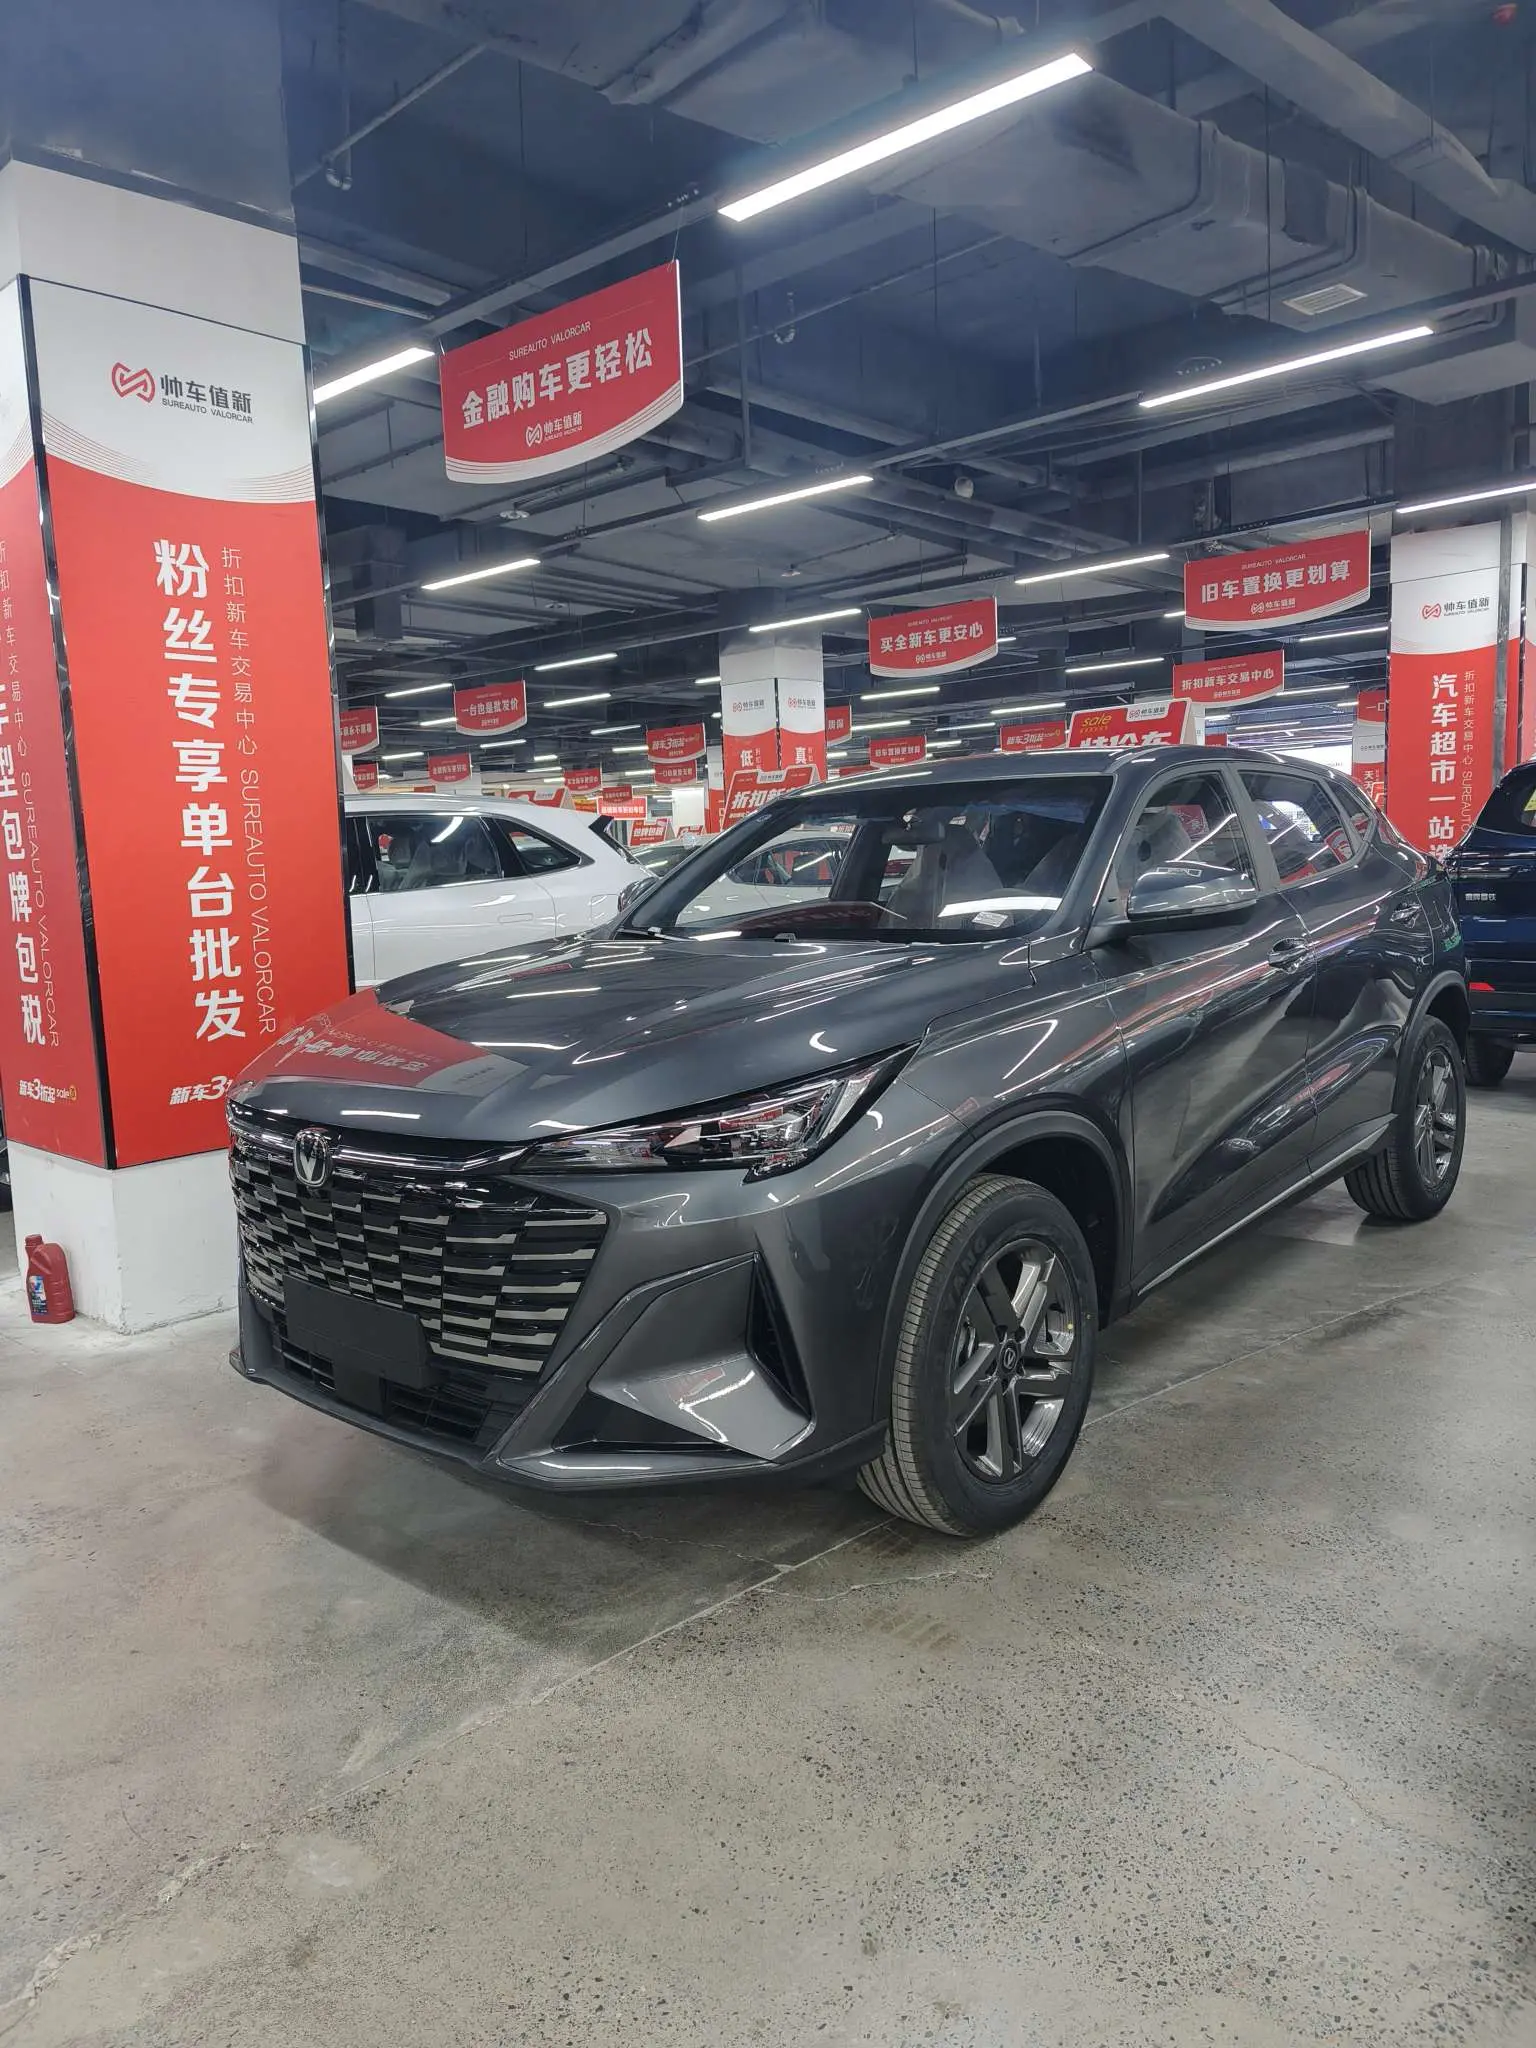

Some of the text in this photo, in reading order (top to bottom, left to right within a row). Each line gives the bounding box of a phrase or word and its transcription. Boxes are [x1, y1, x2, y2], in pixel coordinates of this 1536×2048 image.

[509, 320, 592, 361] SUREAUTO VALORCAR
[160, 374, 251, 413] 帅车值新
[461, 327, 653, 430] 金融购车更轻松
[162, 398, 253, 424] SUREAUTO VALORCAR
[1201, 559, 1350, 604] 旧车置换更划算
[1443, 597, 1490, 612] 帅车值新
[221, 546, 258, 756] 折扣新车交易中心
[880, 621, 984, 653] 买全新车更安心
[1181, 667, 1275, 691] 折扣新车交易中心
[1082, 713, 1112, 727] sale
[1463, 670, 1475, 765] 折扣新车交易中心
[740, 750, 754, 767] 低
[795, 747, 807, 764] 真
[153, 539, 246, 1041] 粉丝专享单台批发
[21, 771, 46, 909] SUREAUTO
[240, 768, 267, 901] SUREAUTO
[38, 914, 59, 1047] VALORCAR
[251, 905, 276, 1034] VALORCAR
[19, 1078, 56, 1104] 新车3折起
